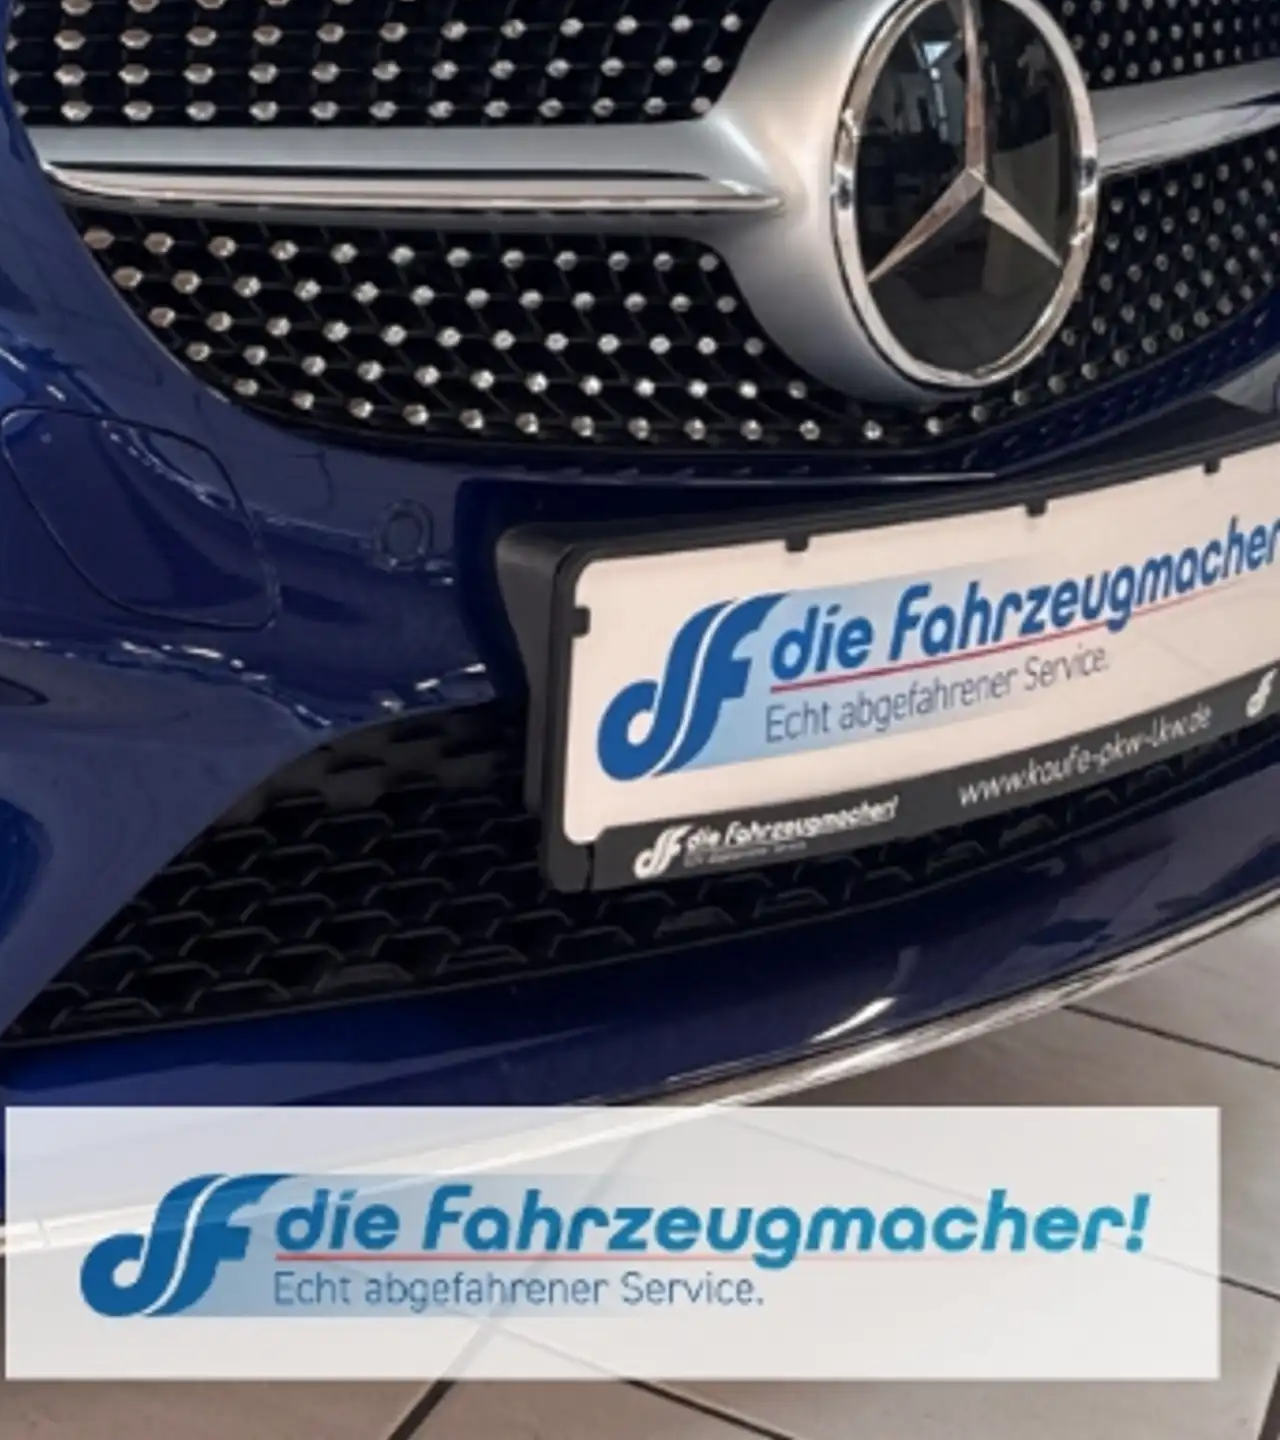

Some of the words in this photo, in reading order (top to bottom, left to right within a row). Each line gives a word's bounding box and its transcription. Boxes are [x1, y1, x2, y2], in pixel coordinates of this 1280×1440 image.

[770, 603, 874, 681] die
[765, 699, 832, 745] Echt
[839, 666, 1019, 734] abgefahrener
[1023, 643, 1110, 692] Service.
